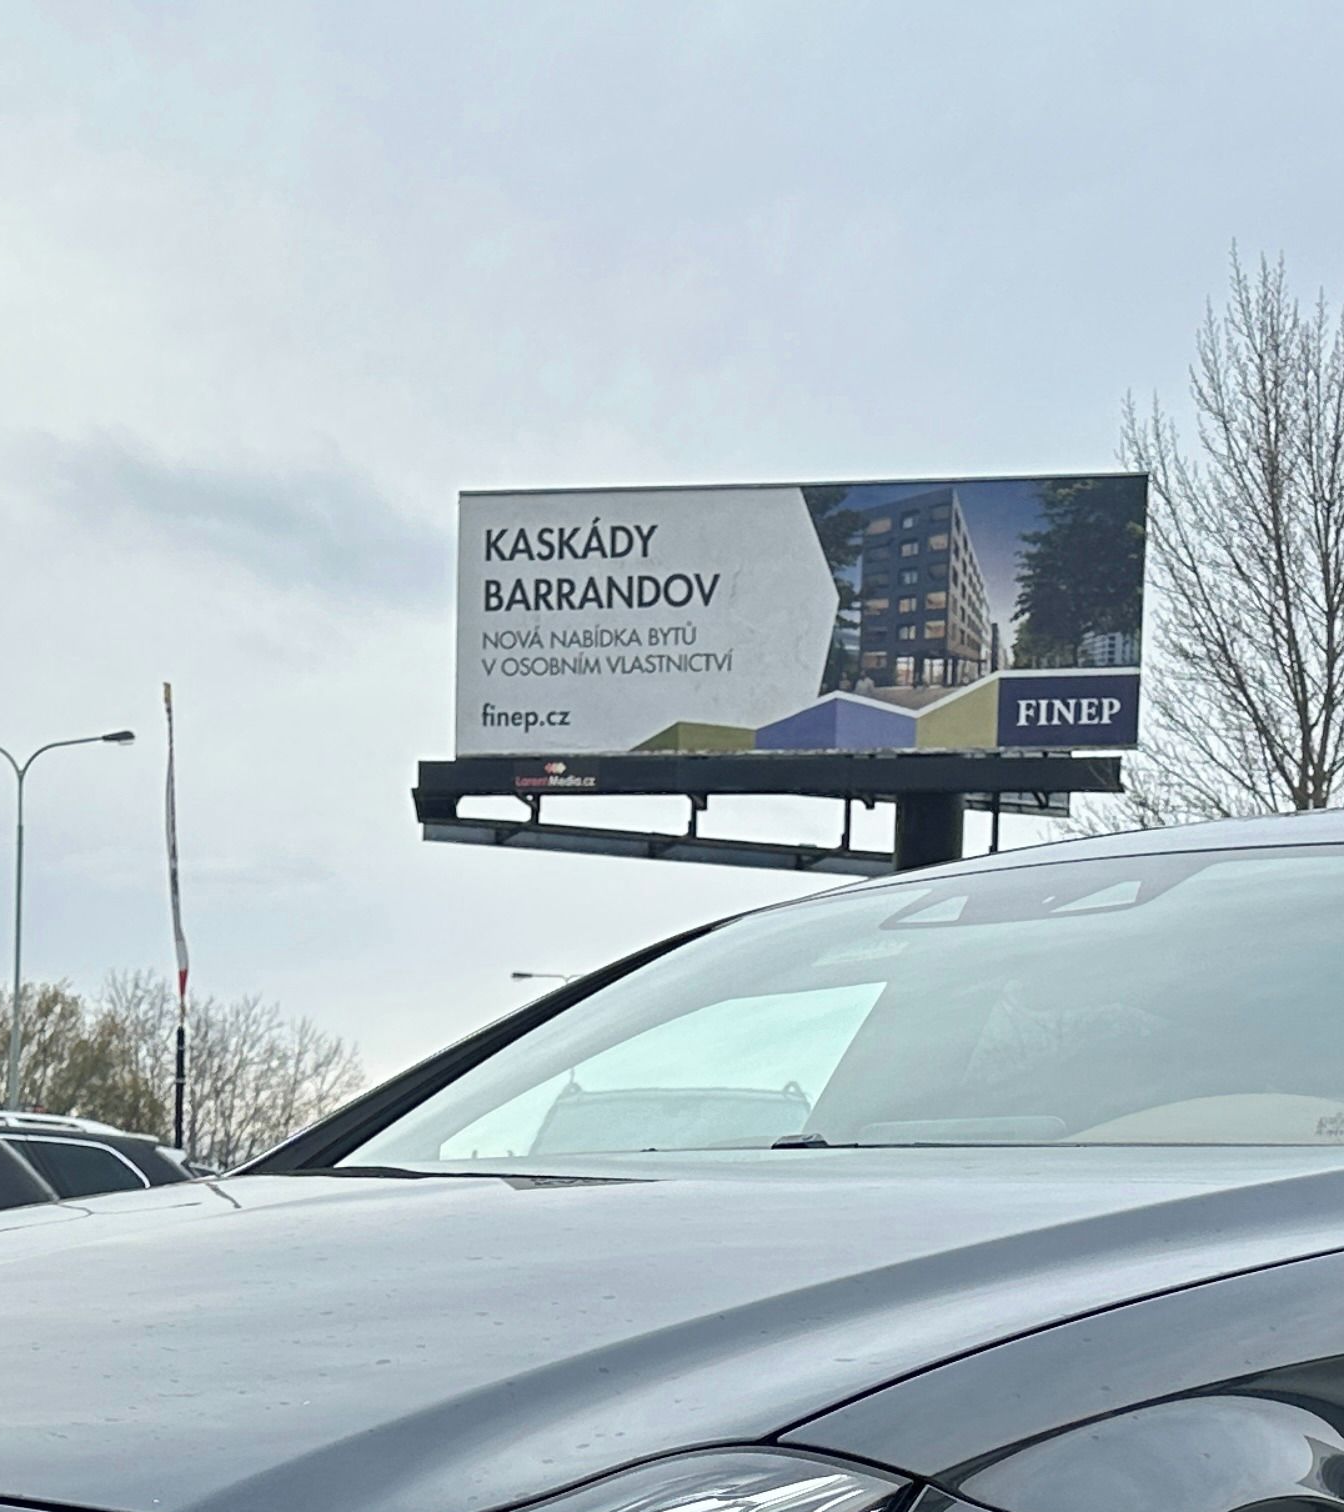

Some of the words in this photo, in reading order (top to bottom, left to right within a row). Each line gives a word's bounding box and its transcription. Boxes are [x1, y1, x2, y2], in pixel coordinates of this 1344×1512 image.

[484, 516, 658, 561] KASKÁDY
[484, 573, 721, 612] BARRANDOV
[481, 625, 544, 650] NOVÁ
[550, 624, 643, 649] NABÍDKA
[648, 621, 697, 646] BYTŮ
[481, 658, 496, 676] V
[501, 651, 602, 677] OSOBNÍM
[606, 649, 734, 675] VLASTNICTVÍ
[482, 703, 571, 733] finep.cz
[1016, 698, 1122, 727] FINEP
